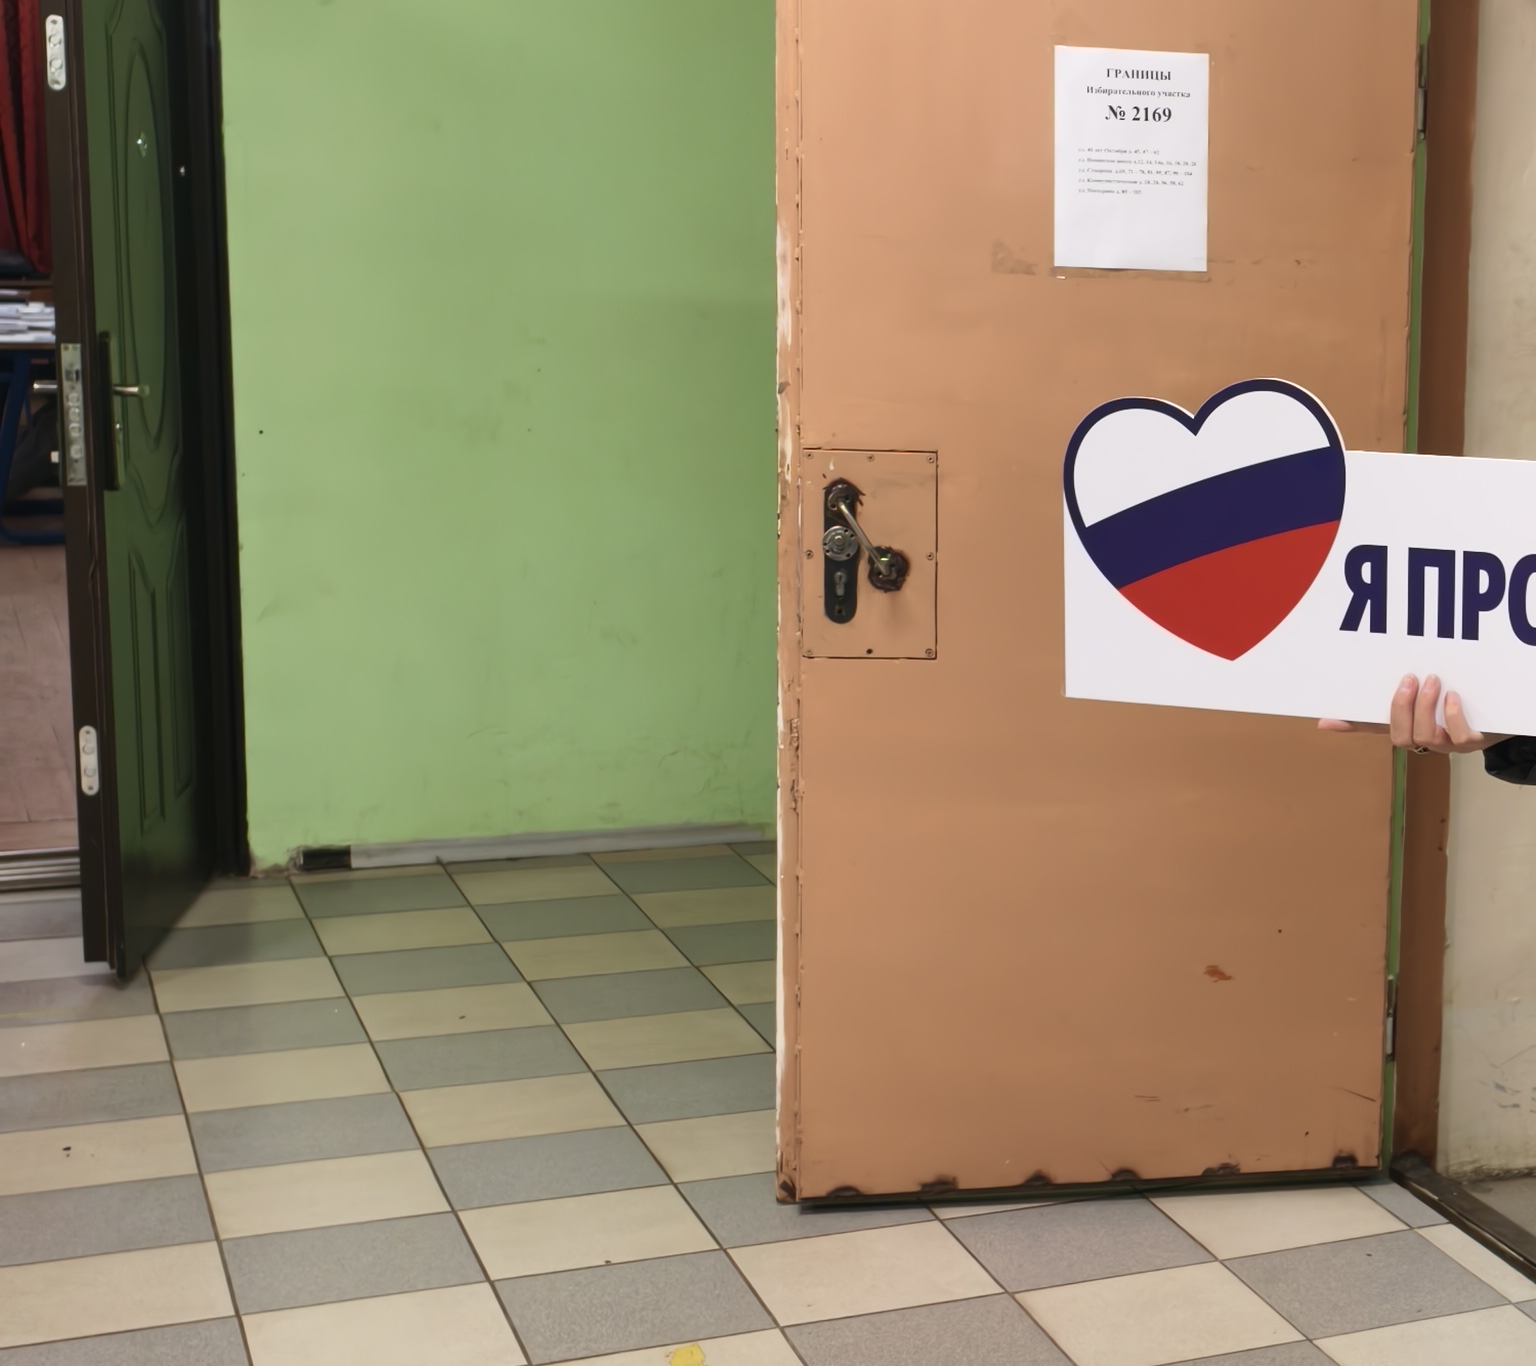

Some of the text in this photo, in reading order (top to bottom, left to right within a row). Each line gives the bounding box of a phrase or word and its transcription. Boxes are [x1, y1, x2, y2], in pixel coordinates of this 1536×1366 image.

[1107, 68, 1171, 81] ГРАНИЦЫ
[1087, 86, 1155, 96] Избирательного
[1105, 105, 1172, 122] № 2169
[1340, 544, 1388, 634] Я
